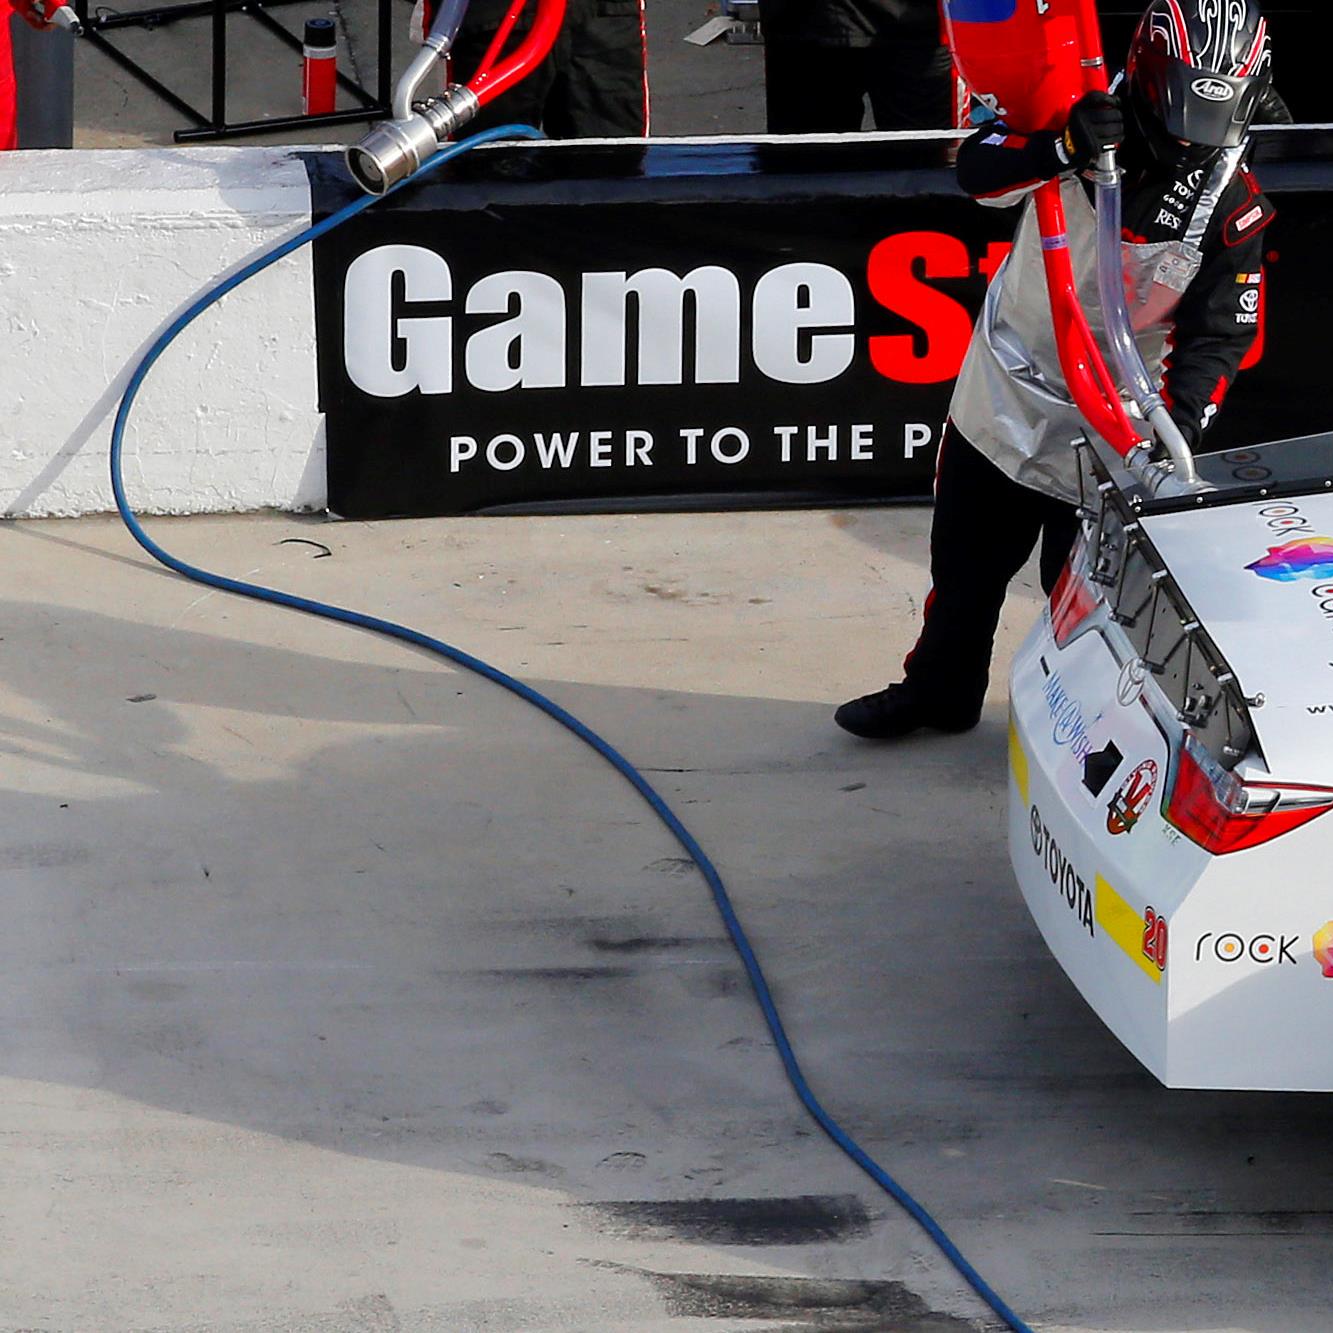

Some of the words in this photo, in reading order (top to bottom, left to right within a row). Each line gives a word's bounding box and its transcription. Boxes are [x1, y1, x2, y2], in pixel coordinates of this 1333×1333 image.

[344, 230, 1014, 398] GameS
[450, 428, 654, 472] POWER
[680, 427, 750, 470] TO
[773, 424, 874, 463] THE
[1043, 829, 1095, 938] TOYOTA
[1142, 905, 1168, 972] 20
[1194, 931, 1299, 966] rock
